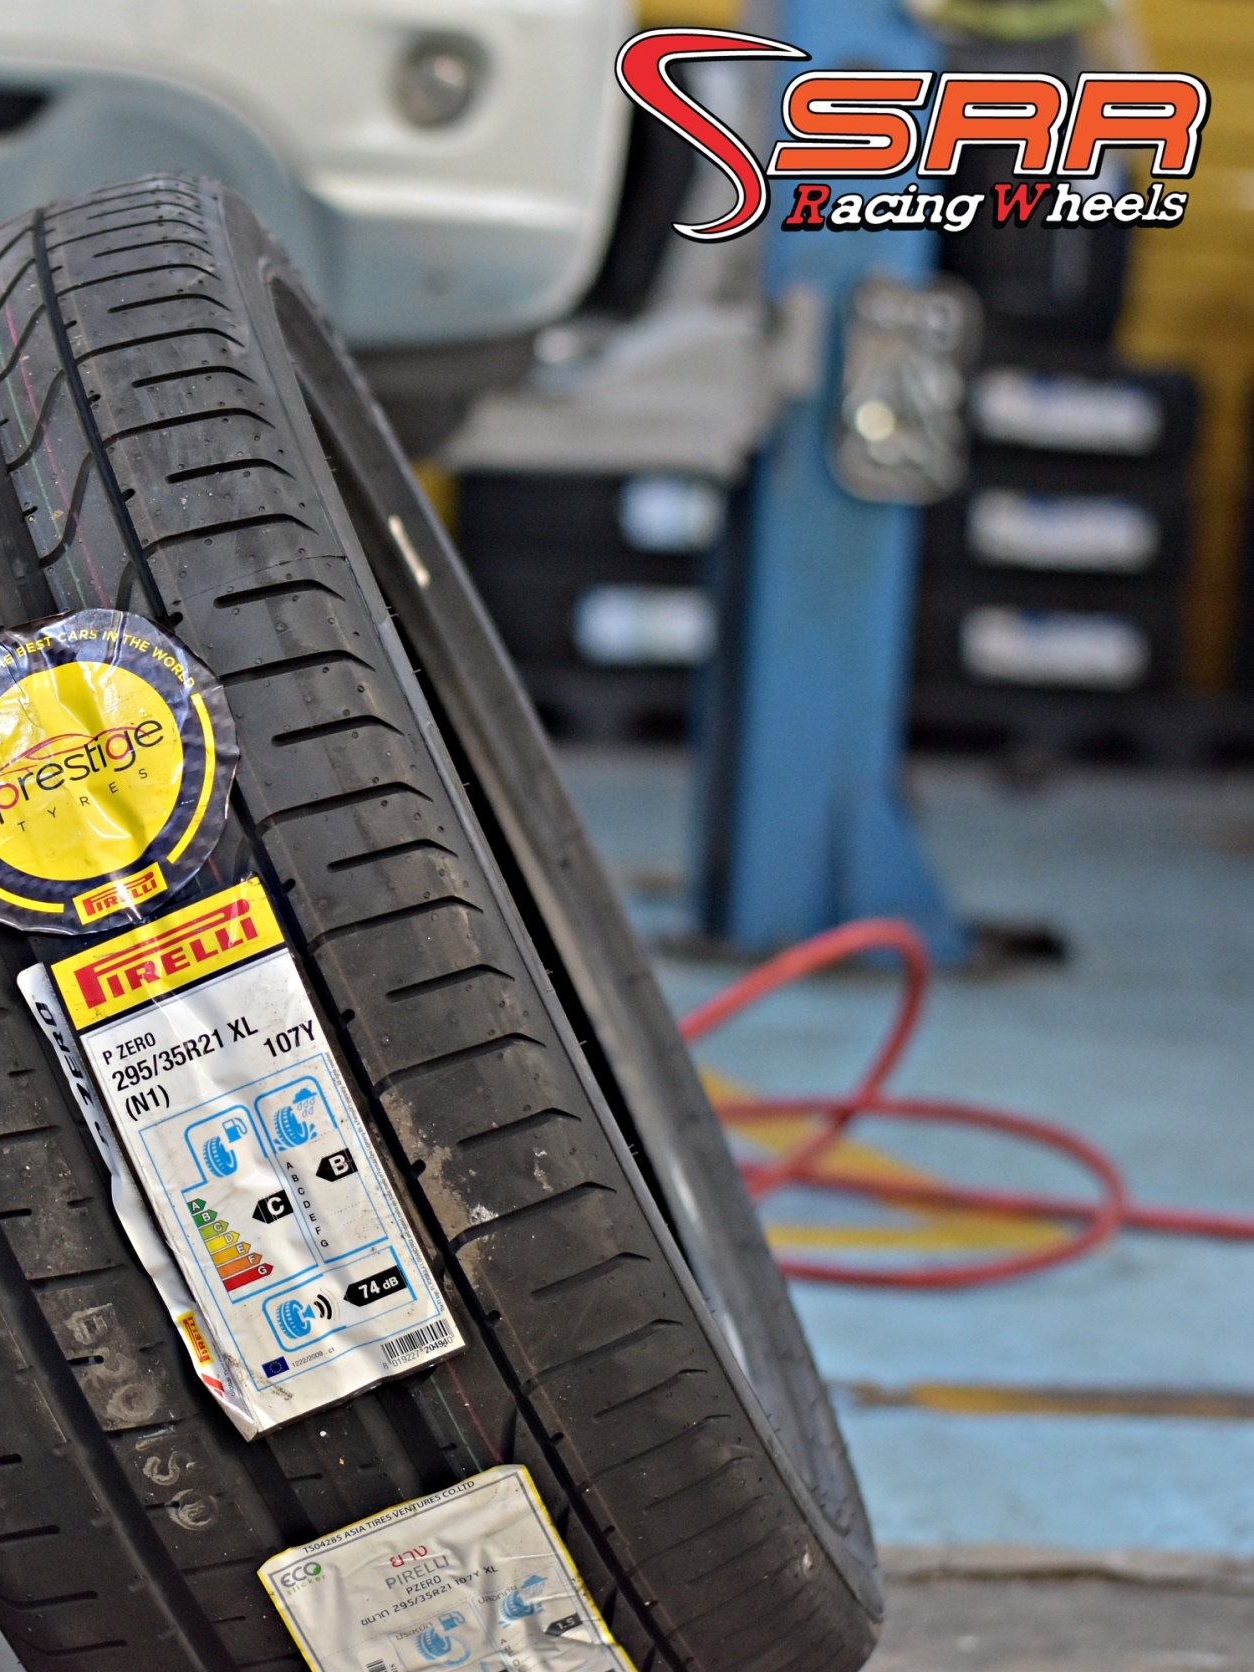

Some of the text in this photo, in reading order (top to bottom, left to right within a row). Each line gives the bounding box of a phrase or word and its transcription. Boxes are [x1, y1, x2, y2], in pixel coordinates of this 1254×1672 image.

[16, 636, 52, 657] BEST
[58, 630, 97, 642] CARS
[102, 630, 119, 642] IN
[122, 633, 148, 653] THE
[152, 646, 195, 689] WORLD
[17, 768, 148, 832] TYRES
[82, 871, 159, 916] PIRELLI
[74, 898, 258, 1010] PIRELLI
[34, 1001, 93, 1107] ZERO
[102, 1031, 157, 1065] P ZERO
[111, 1016, 258, 1092] 295/35R21 XL
[125, 1019, 317, 1122] (N1) 107Y
[286, 1162, 294, 1170] A
[328, 1154, 350, 1176] B
[291, 1174, 299, 1182] B
[298, 1187, 305, 1195] C
[192, 1202, 200, 1210] A
[267, 1196, 285, 1215] C
[304, 1200, 311, 1208] D
[202, 1212, 210, 1222] B
[213, 1223, 222, 1232] C
[310, 1213, 317, 1222] E
[225, 1234, 234, 1243] D
[315, 1226, 322, 1235] F
[236, 1244, 245, 1253] E
[320, 1239, 329, 1248] G
[248, 1254, 256, 1264] F
[257, 1265, 267, 1275] G
[358, 1276, 399, 1299] 74 dB
[182, 1316, 212, 1364] PIRELLI
[383, 1336, 454, 1369] 8 019227 204940
[302, 1480, 475, 1554] TS04285 ASIA TIRES VENTURES CO.LTD
[389, 1544, 428, 1568] ยาง
[280, 1561, 321, 1588] ECO
[385, 1555, 449, 1590] PIRELLI
[286, 1574, 326, 1596] sticker
[360, 1565, 498, 1627] ขนาด 295/35R21 107Y XL
[406, 1575, 442, 1595] PZERO
[557, 1617, 575, 1630] 1.5
